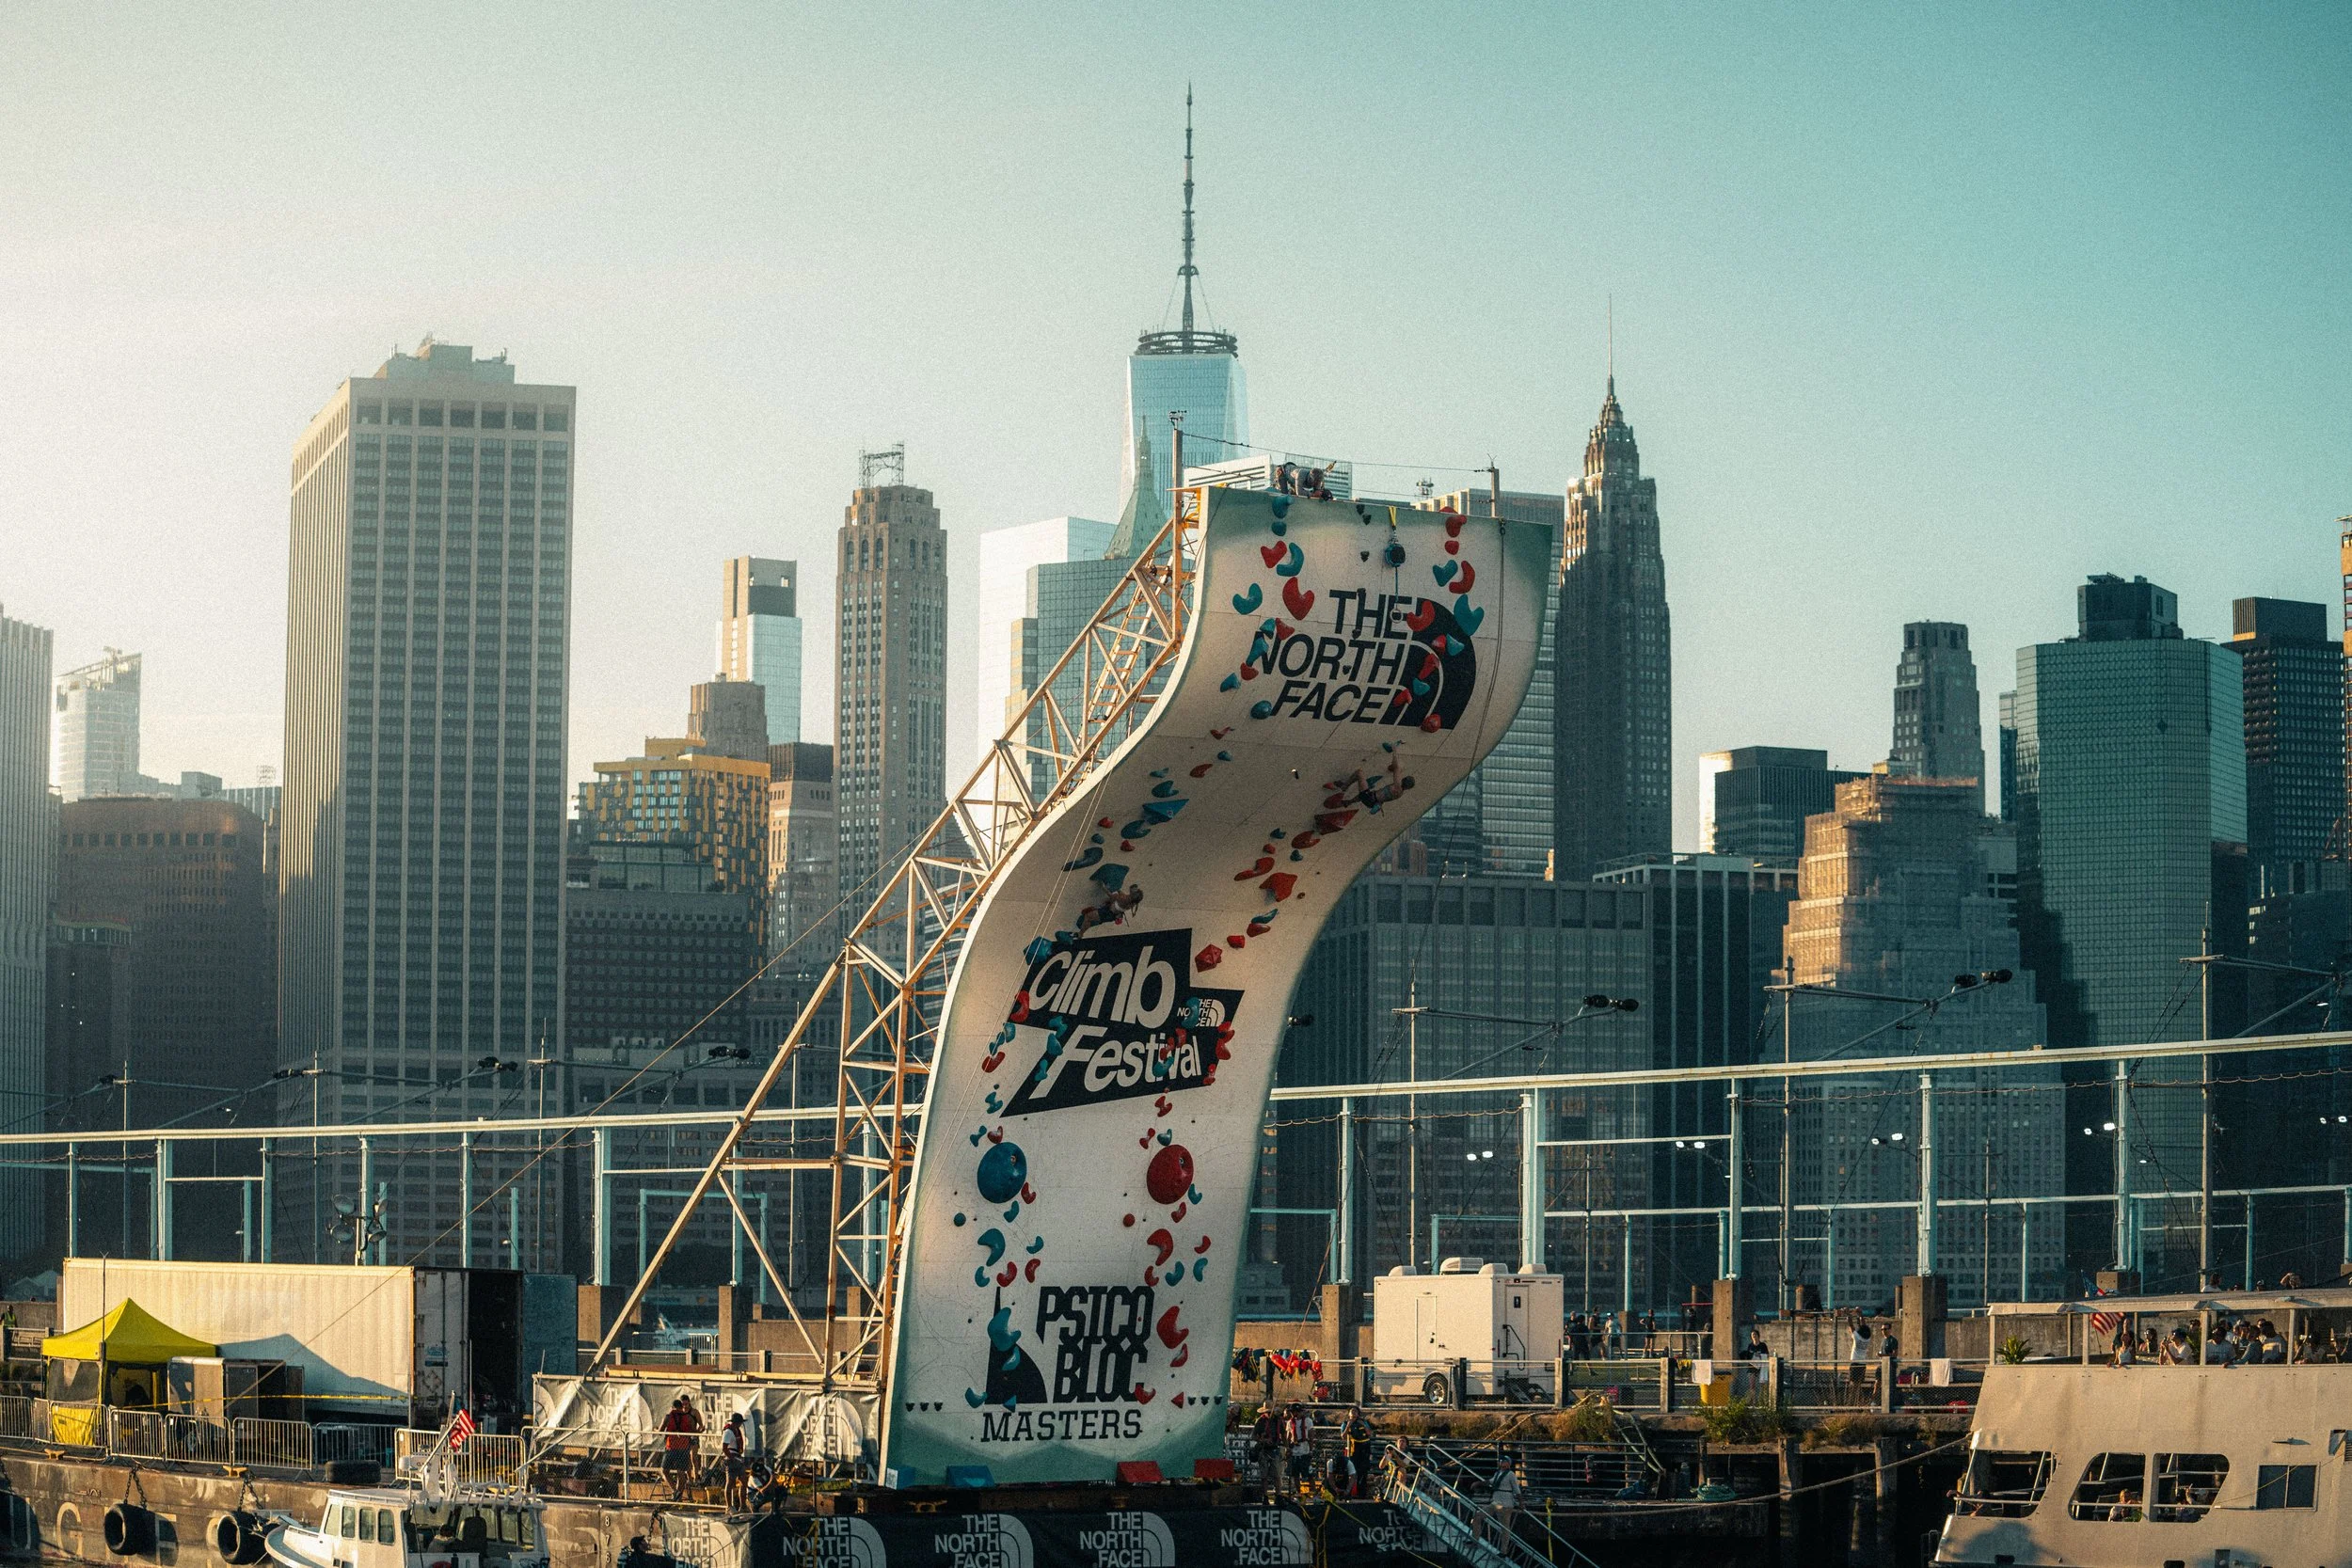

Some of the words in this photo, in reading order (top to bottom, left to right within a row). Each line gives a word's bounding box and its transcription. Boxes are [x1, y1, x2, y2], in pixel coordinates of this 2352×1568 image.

[1329, 590, 1412, 640] THE
[1255, 631, 1409, 686] NORTH
[1270, 680, 1391, 723] FACE
[1029, 946, 1176, 1029] Climb
[1177, 1007, 1210, 1017] NOTH
[1198, 999, 1213, 1008] HE
[1036, 1286, 1154, 1344] PSICO
[1053, 1337, 1148, 1403] BLOC
[704, 1393, 732, 1411] THE
[705, 1412, 731, 1433] RTH
[980, 1409, 1142, 1443] MASTERS
[605, 1516, 611, 1527] 8
[682, 1518, 709, 1537] THE
[811, 1517, 848, 1536] THE
[962, 1514, 999, 1532] THE
[1106, 1512, 1141, 1529] THE
[1247, 1510, 1280, 1528] THE
[605, 1535, 611, 1545] 7
[783, 1536, 849, 1556] NORTH
[934, 1532, 1000, 1552] NORTH
[1080, 1530, 1142, 1549] NORTH
[1221, 1528, 1281, 1547] NORTH
[605, 1553, 611, 1563] 6
[955, 1552, 1000, 1568] FACE
[1098, 1549, 1142, 1568] FACE
[1238, 1546, 1281, 1565] FACE
